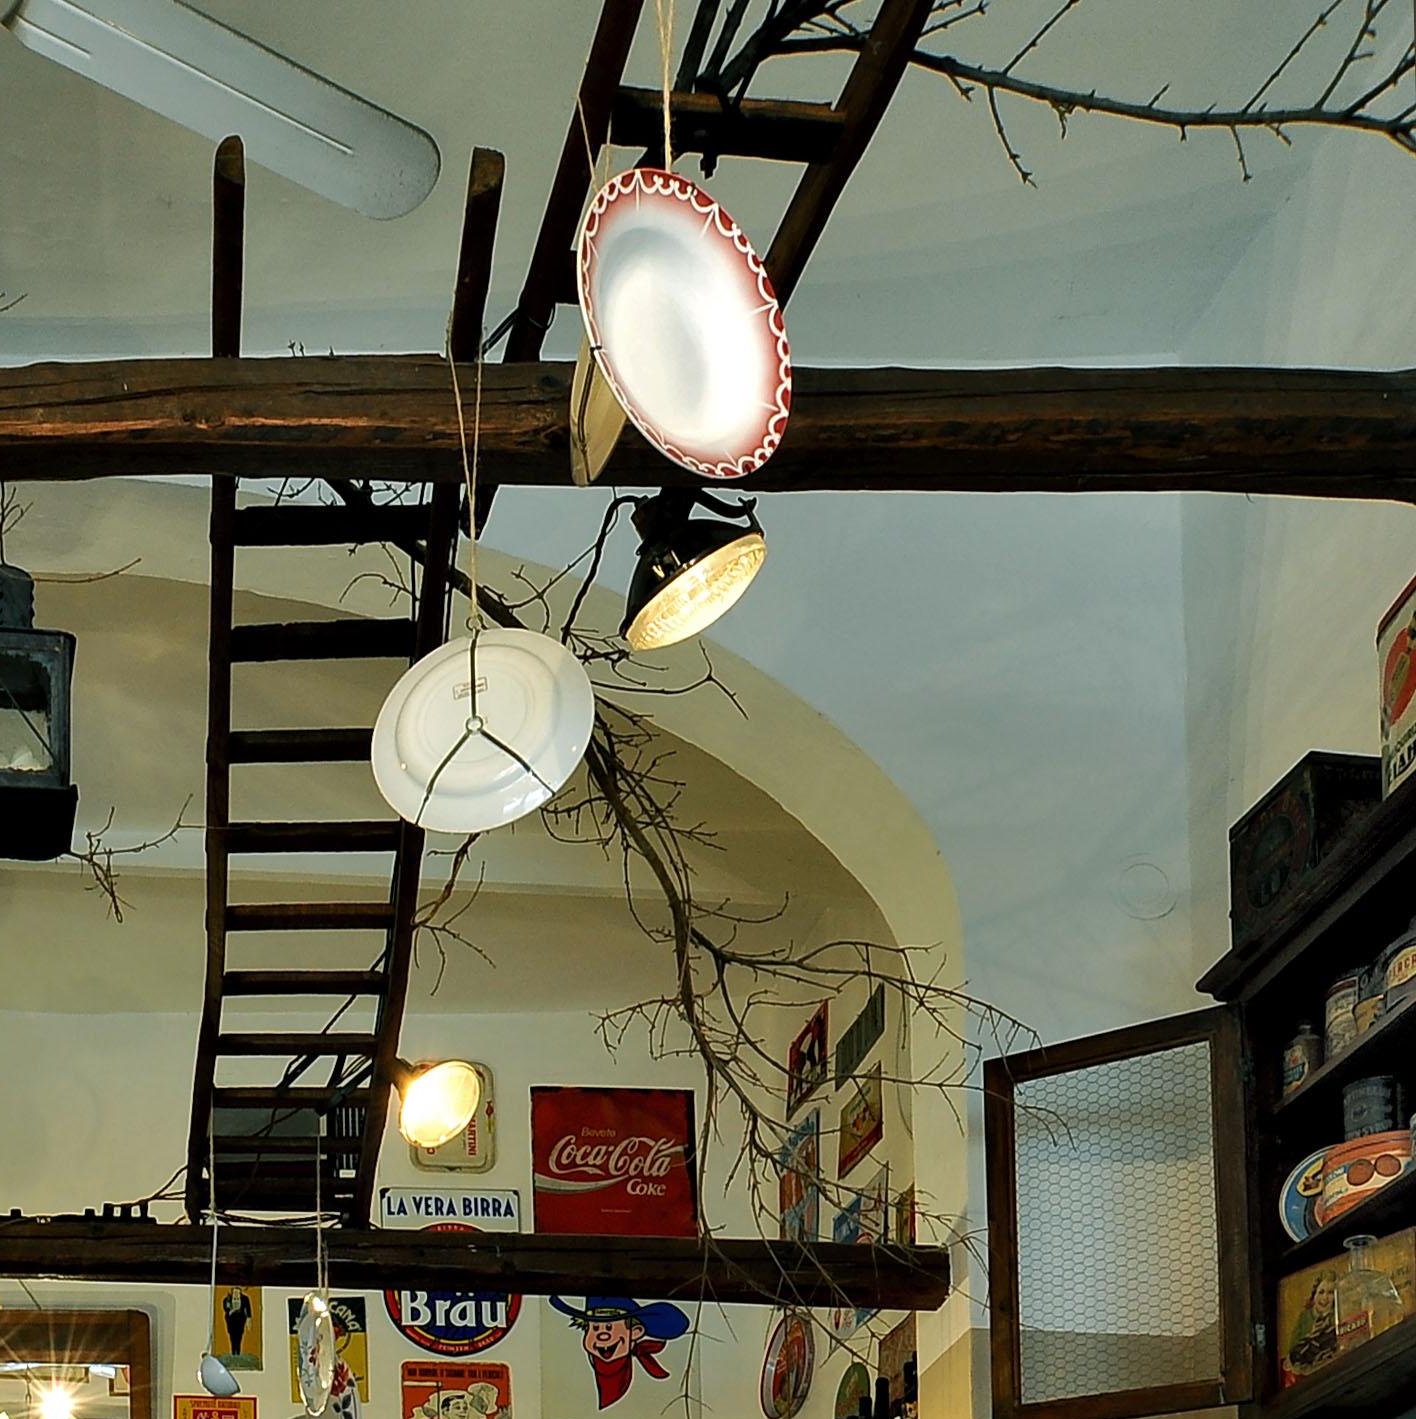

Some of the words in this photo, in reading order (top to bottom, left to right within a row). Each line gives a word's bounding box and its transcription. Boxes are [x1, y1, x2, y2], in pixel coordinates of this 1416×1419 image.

[548, 1134, 675, 1177] Coca-Cola
[626, 1178, 667, 1196] Coke
[386, 1196, 408, 1216] LA
[412, 1196, 456, 1217] VERA
[463, 1197, 515, 1218] BIRRA
[401, 1289, 507, 1328] Bräu
